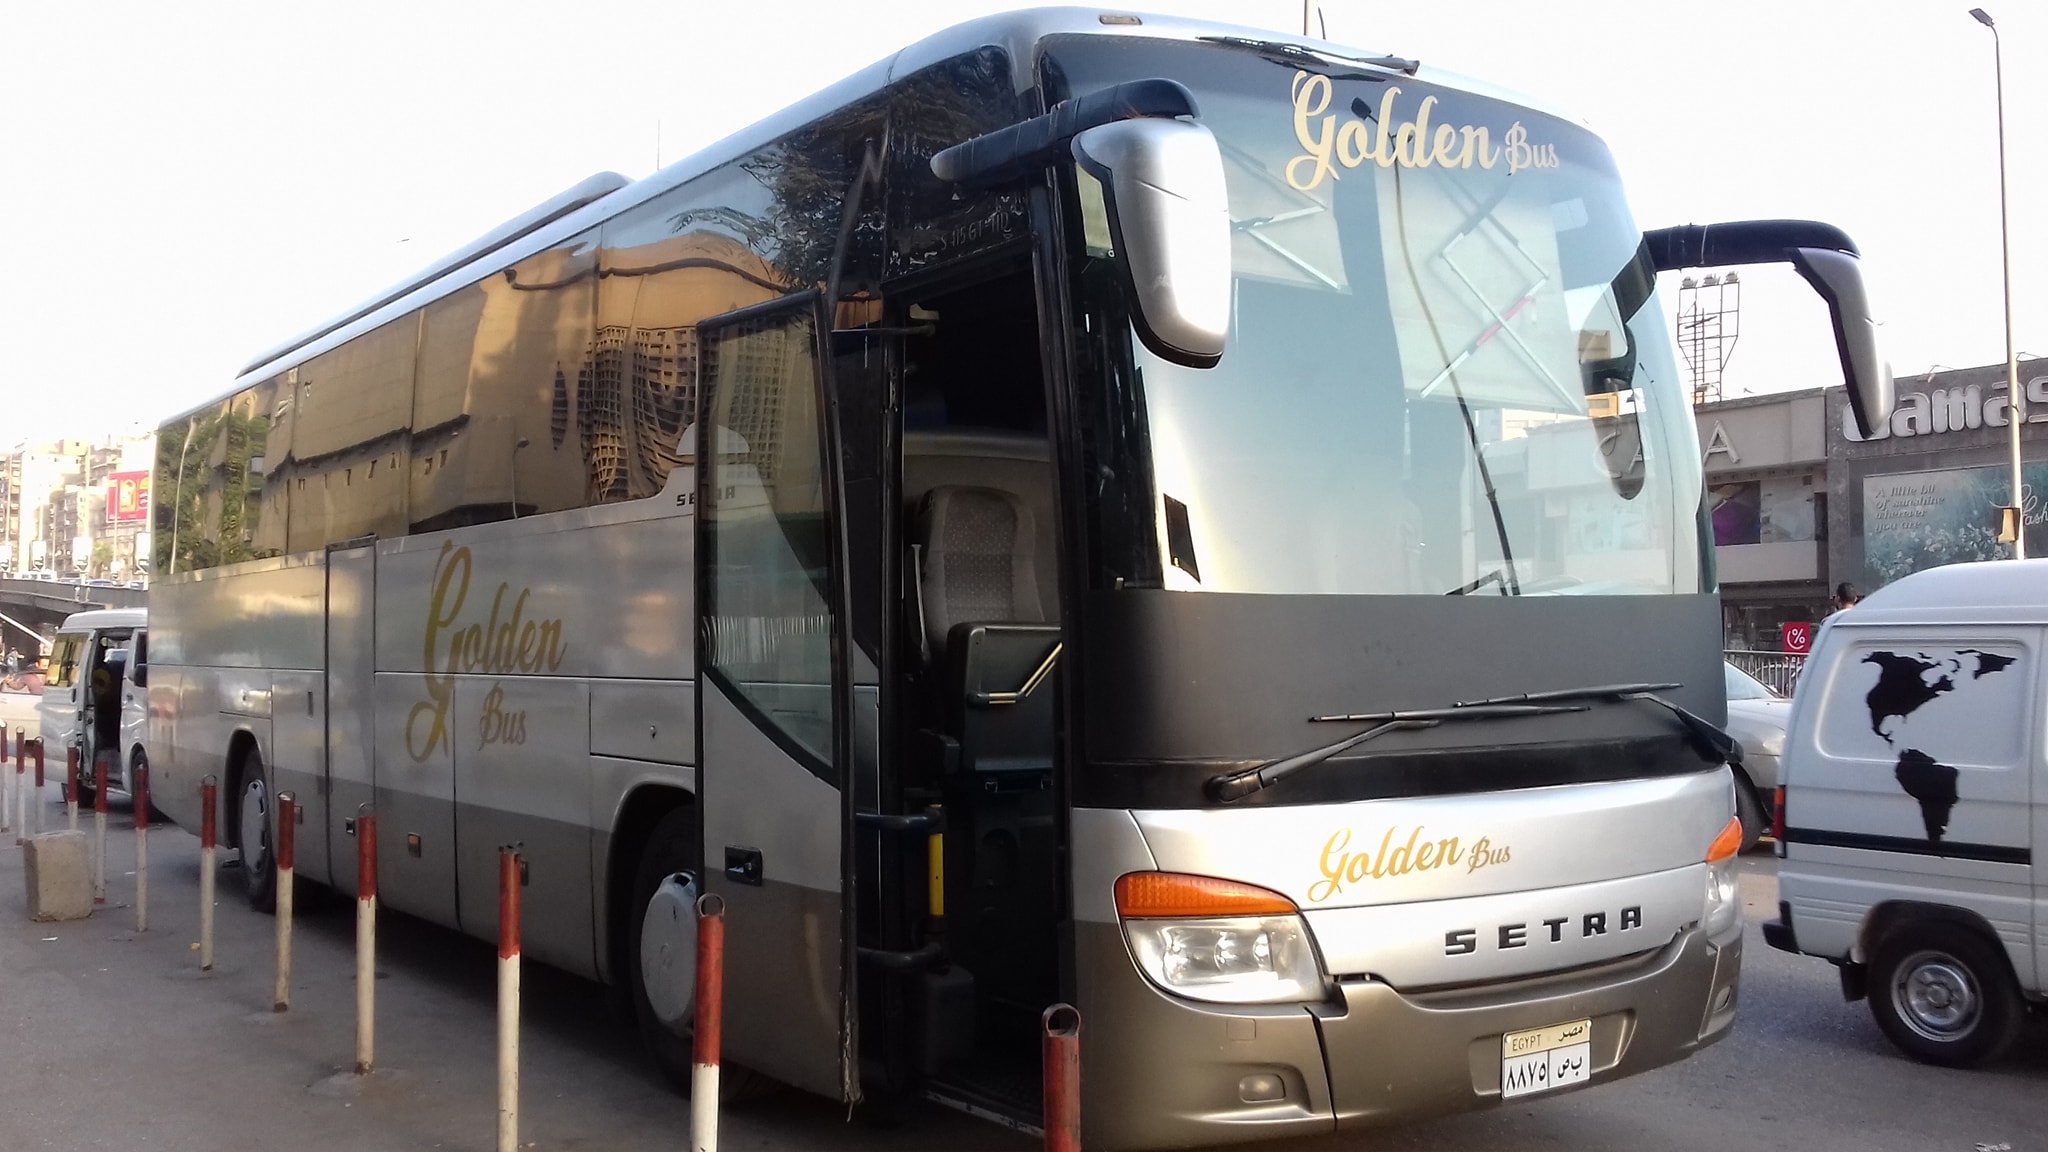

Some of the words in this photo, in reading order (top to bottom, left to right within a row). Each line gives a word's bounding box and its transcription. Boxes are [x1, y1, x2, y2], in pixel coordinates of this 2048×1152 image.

[1285, 70, 1500, 191] Golden
[1504, 121, 1560, 176] Bus
[406, 539, 567, 763] Golden
[479, 682, 526, 751] Bus
[1307, 825, 1465, 903] Golden
[1467, 835, 1511, 875] Bus
[1444, 904, 1643, 956] SETRA
[1512, 1034, 1541, 1052] EGYPT
[1558, 1025, 1583, 1042] مصر
